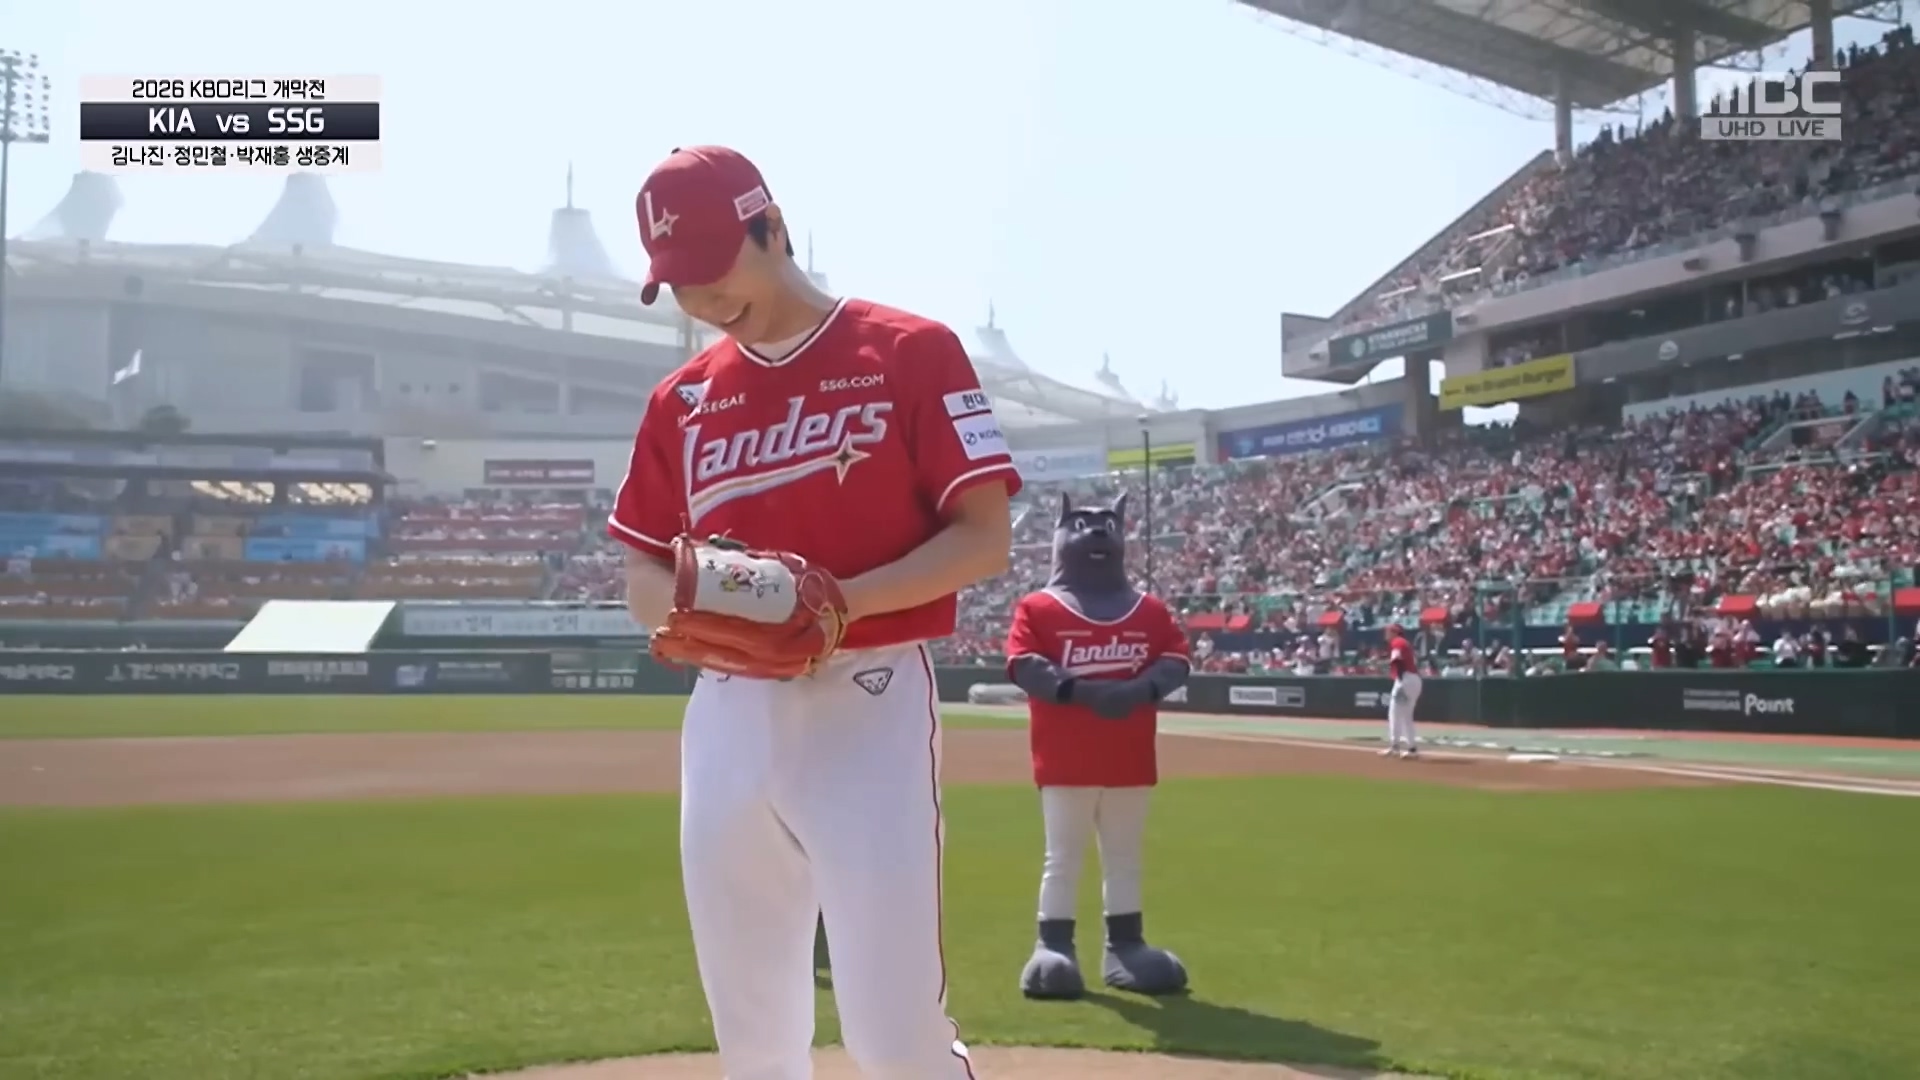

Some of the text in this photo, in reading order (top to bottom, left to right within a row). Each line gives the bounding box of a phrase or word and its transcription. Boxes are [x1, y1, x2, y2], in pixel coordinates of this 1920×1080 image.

[819, 373, 885, 393] SSG.COM
[684, 395, 893, 518] Landers
[1062, 635, 1150, 671] Landers
[1744, 693, 1795, 716] Point
